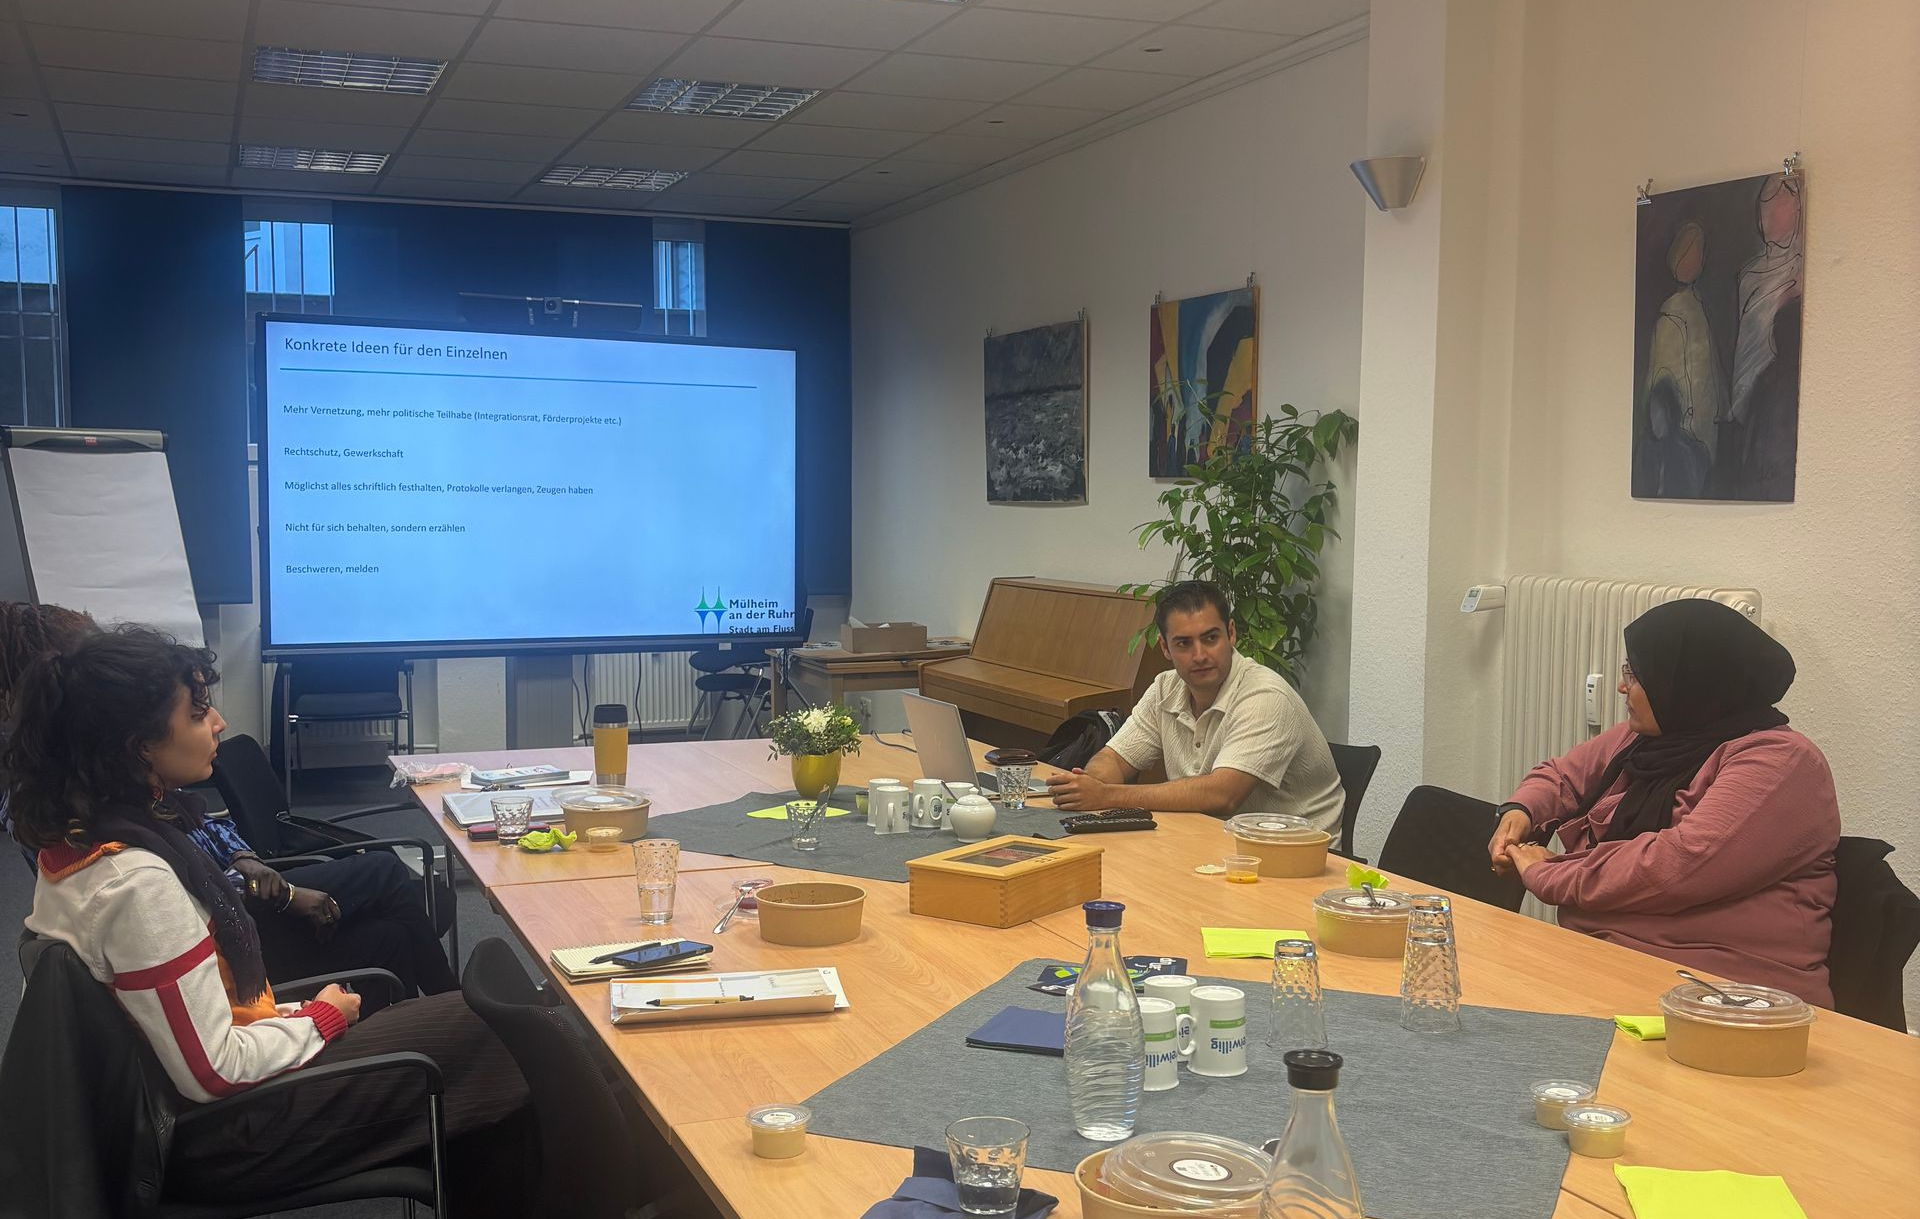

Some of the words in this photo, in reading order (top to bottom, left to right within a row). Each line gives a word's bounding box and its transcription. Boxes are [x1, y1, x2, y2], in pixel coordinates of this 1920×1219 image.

[285, 338, 347, 352] Konkrete
[352, 341, 389, 355] Ideen
[394, 342, 412, 355] für
[417, 344, 442, 357] den
[446, 345, 508, 360] Einzelnen
[283, 405, 308, 414] Mehr
[310, 406, 365, 417] Vernetzung,
[367, 408, 391, 417] mehr
[392, 409, 435, 419] politische
[436, 410, 472, 420] Teilhabe
[474, 411, 541, 423] (Integrationsrat,
[543, 414, 602, 425] Förderprojekte
[604, 416, 622, 426] etc.)
[284, 447, 341, 458] Rechtschutz,
[343, 448, 404, 458] Gewerkschaft
[284, 481, 329, 492] Möglichst
[331, 481, 352, 491] alles
[353, 482, 396, 491] schriftlich
[399, 482, 445, 493] festhalten,
[447, 484, 489, 493] Protokolle
[492, 485, 535, 495] verlangen,
[537, 485, 566, 495] Zeugen
[569, 486, 593, 494] haben
[285, 523, 309, 532] Nicht
[311, 523, 325, 532] für
[327, 523, 345, 532] sich
[347, 523, 389, 533] behalten,
[391, 523, 427, 533] sondern
[429, 523, 466, 533] erzählen
[286, 564, 343, 575] Beschweren,
[345, 564, 379, 574] melden
[729, 599, 778, 609] Mülheim
[729, 611, 742, 620] an
[746, 610, 765, 619] der
[768, 609, 796, 619] Ruhr
[729, 625, 753, 634] Stadt
[756, 626, 770, 634] am
